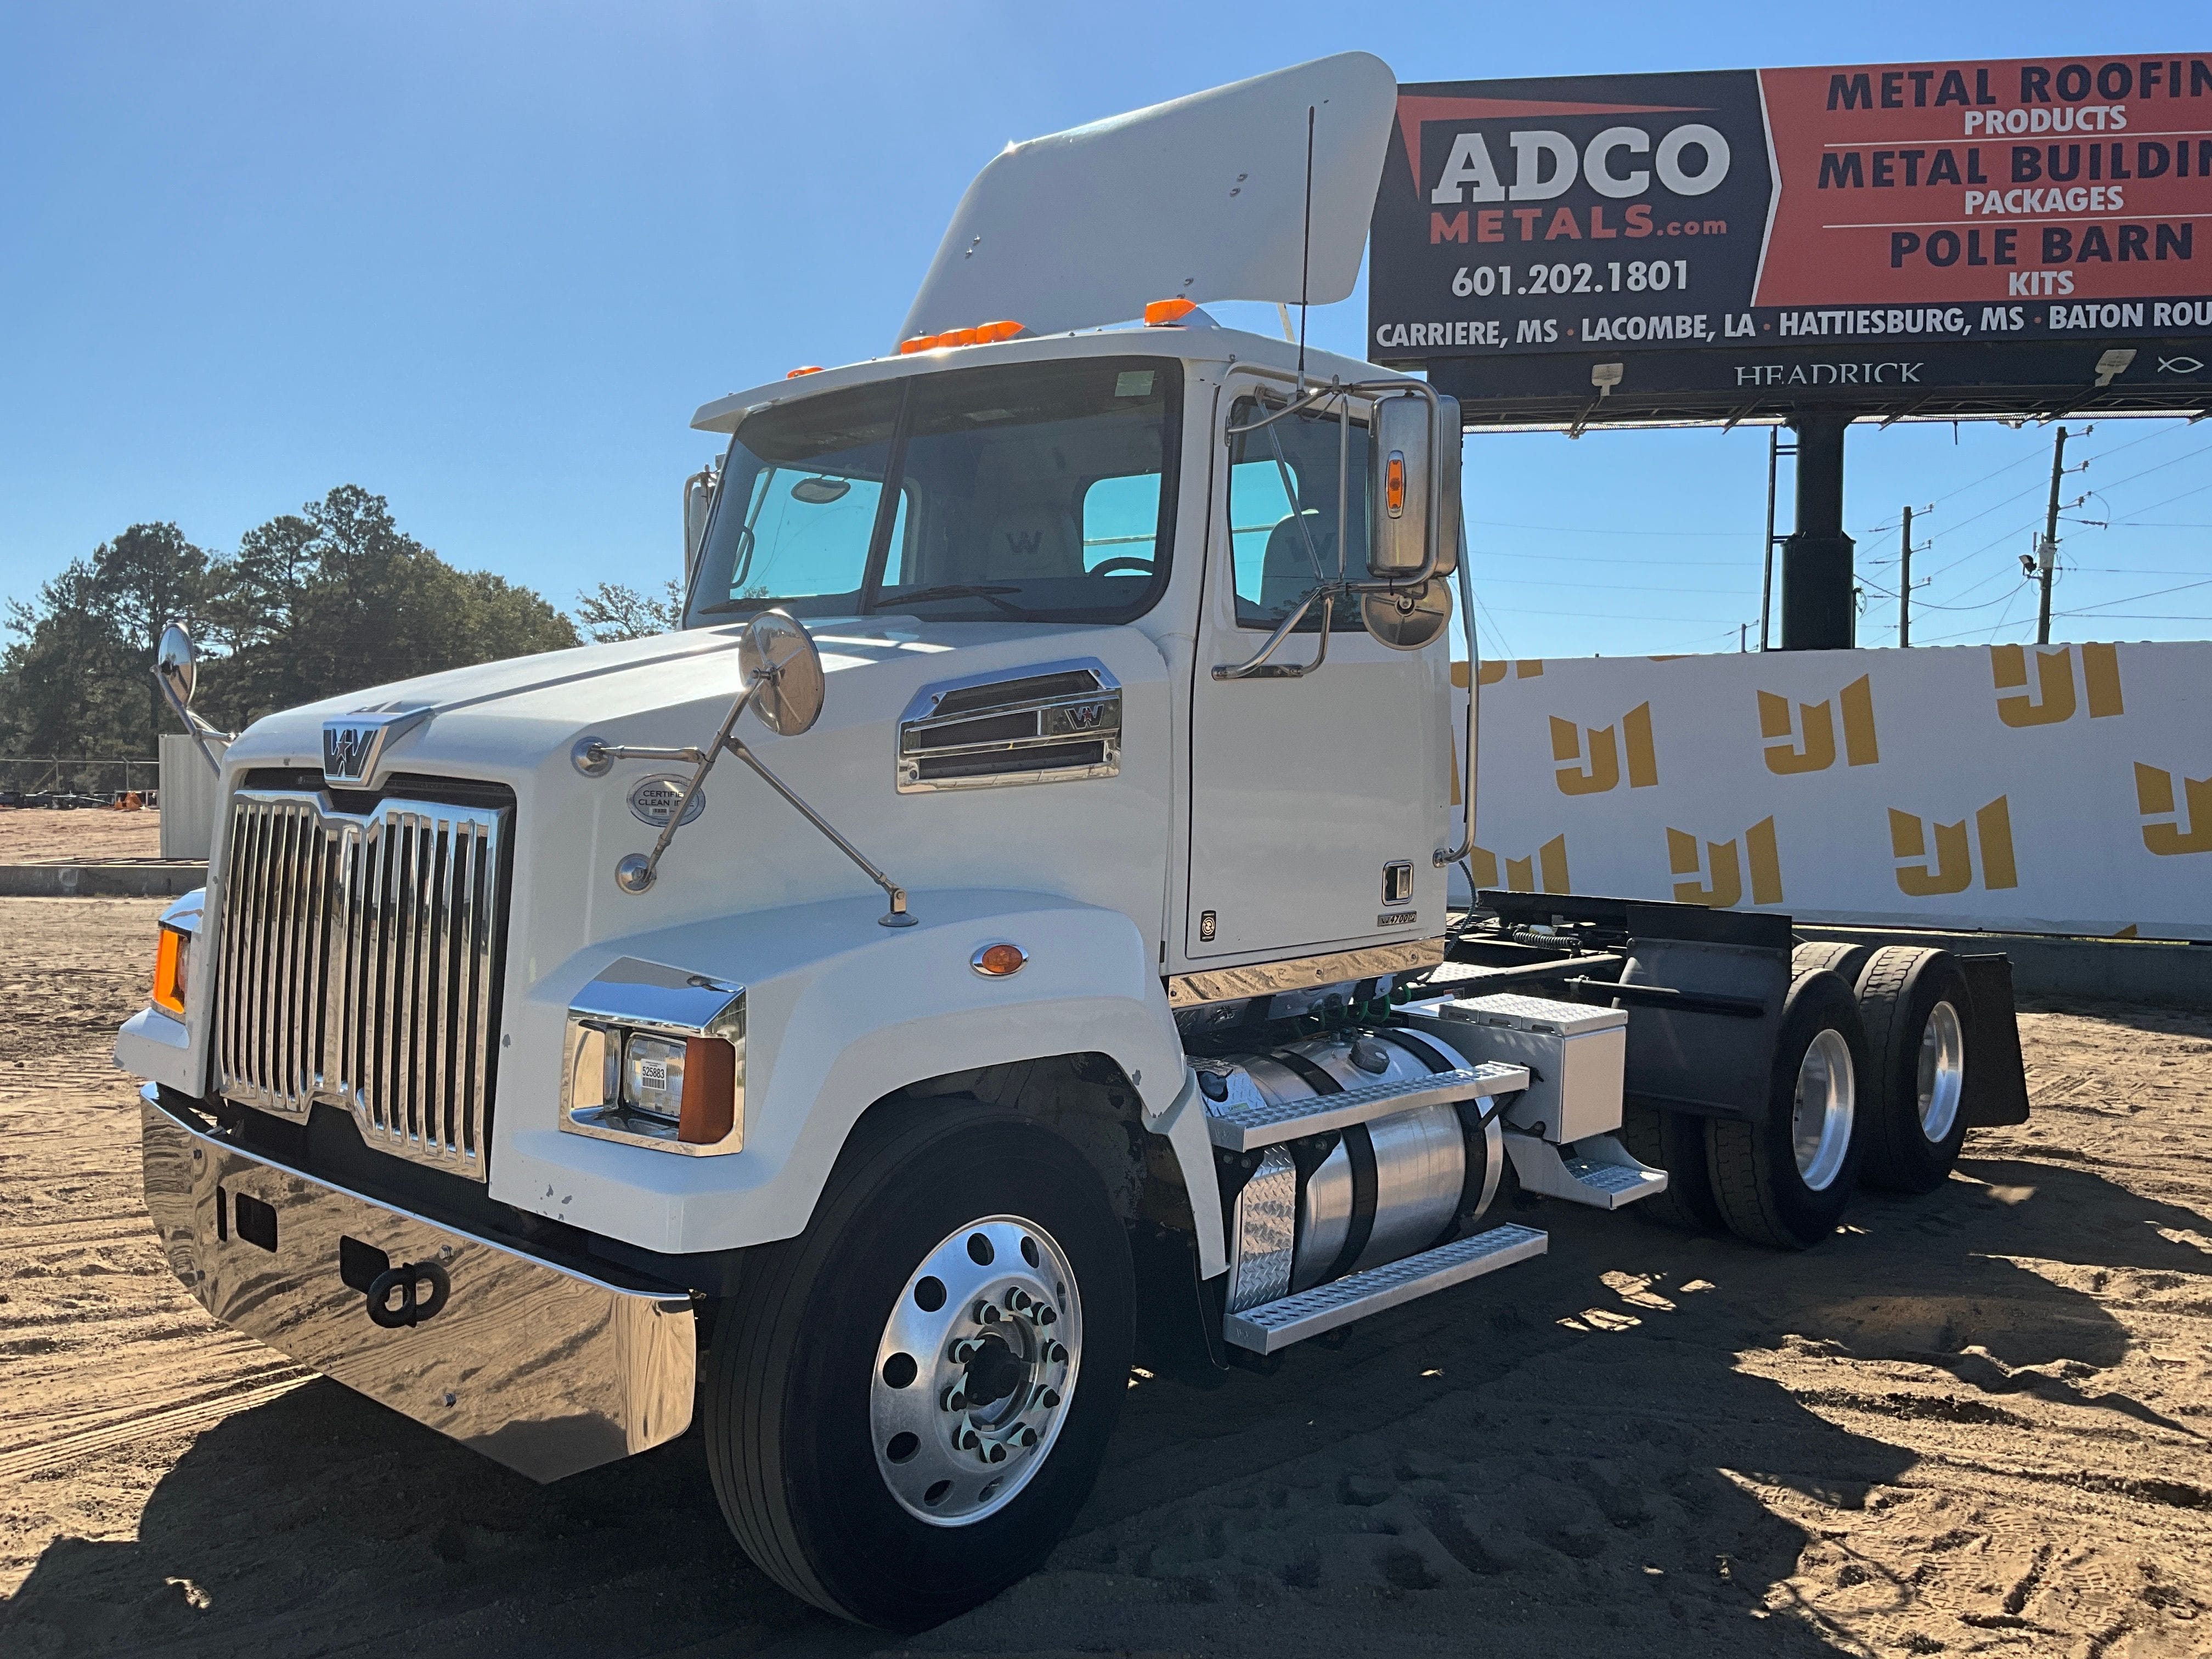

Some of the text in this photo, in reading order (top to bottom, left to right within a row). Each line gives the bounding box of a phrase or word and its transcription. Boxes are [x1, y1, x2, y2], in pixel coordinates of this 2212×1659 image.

[1826, 68, 1996, 110] METAL
[1965, 105, 2128, 135] PRODUCTS
[1431, 124, 1730, 204] ADCO
[1818, 149, 1987, 189] METAL
[1965, 186, 2124, 215] PACKAGES
[1430, 205, 1728, 245] METALS.com
[1891, 223, 2192, 268] POLE BARN
[1452, 260, 1688, 297] 601.202.1801
[2009, 270, 2074, 296] KITS
[1376, 301, 2212, 348] CARRIERE, MS LACOMBE, LA HATTIESBURG, MS BATON ROU
[1734, 363, 1924, 386] HEADRICK
[1391, 915, 1408, 924] 4700
[642, 1066, 664, 1079] 525883
